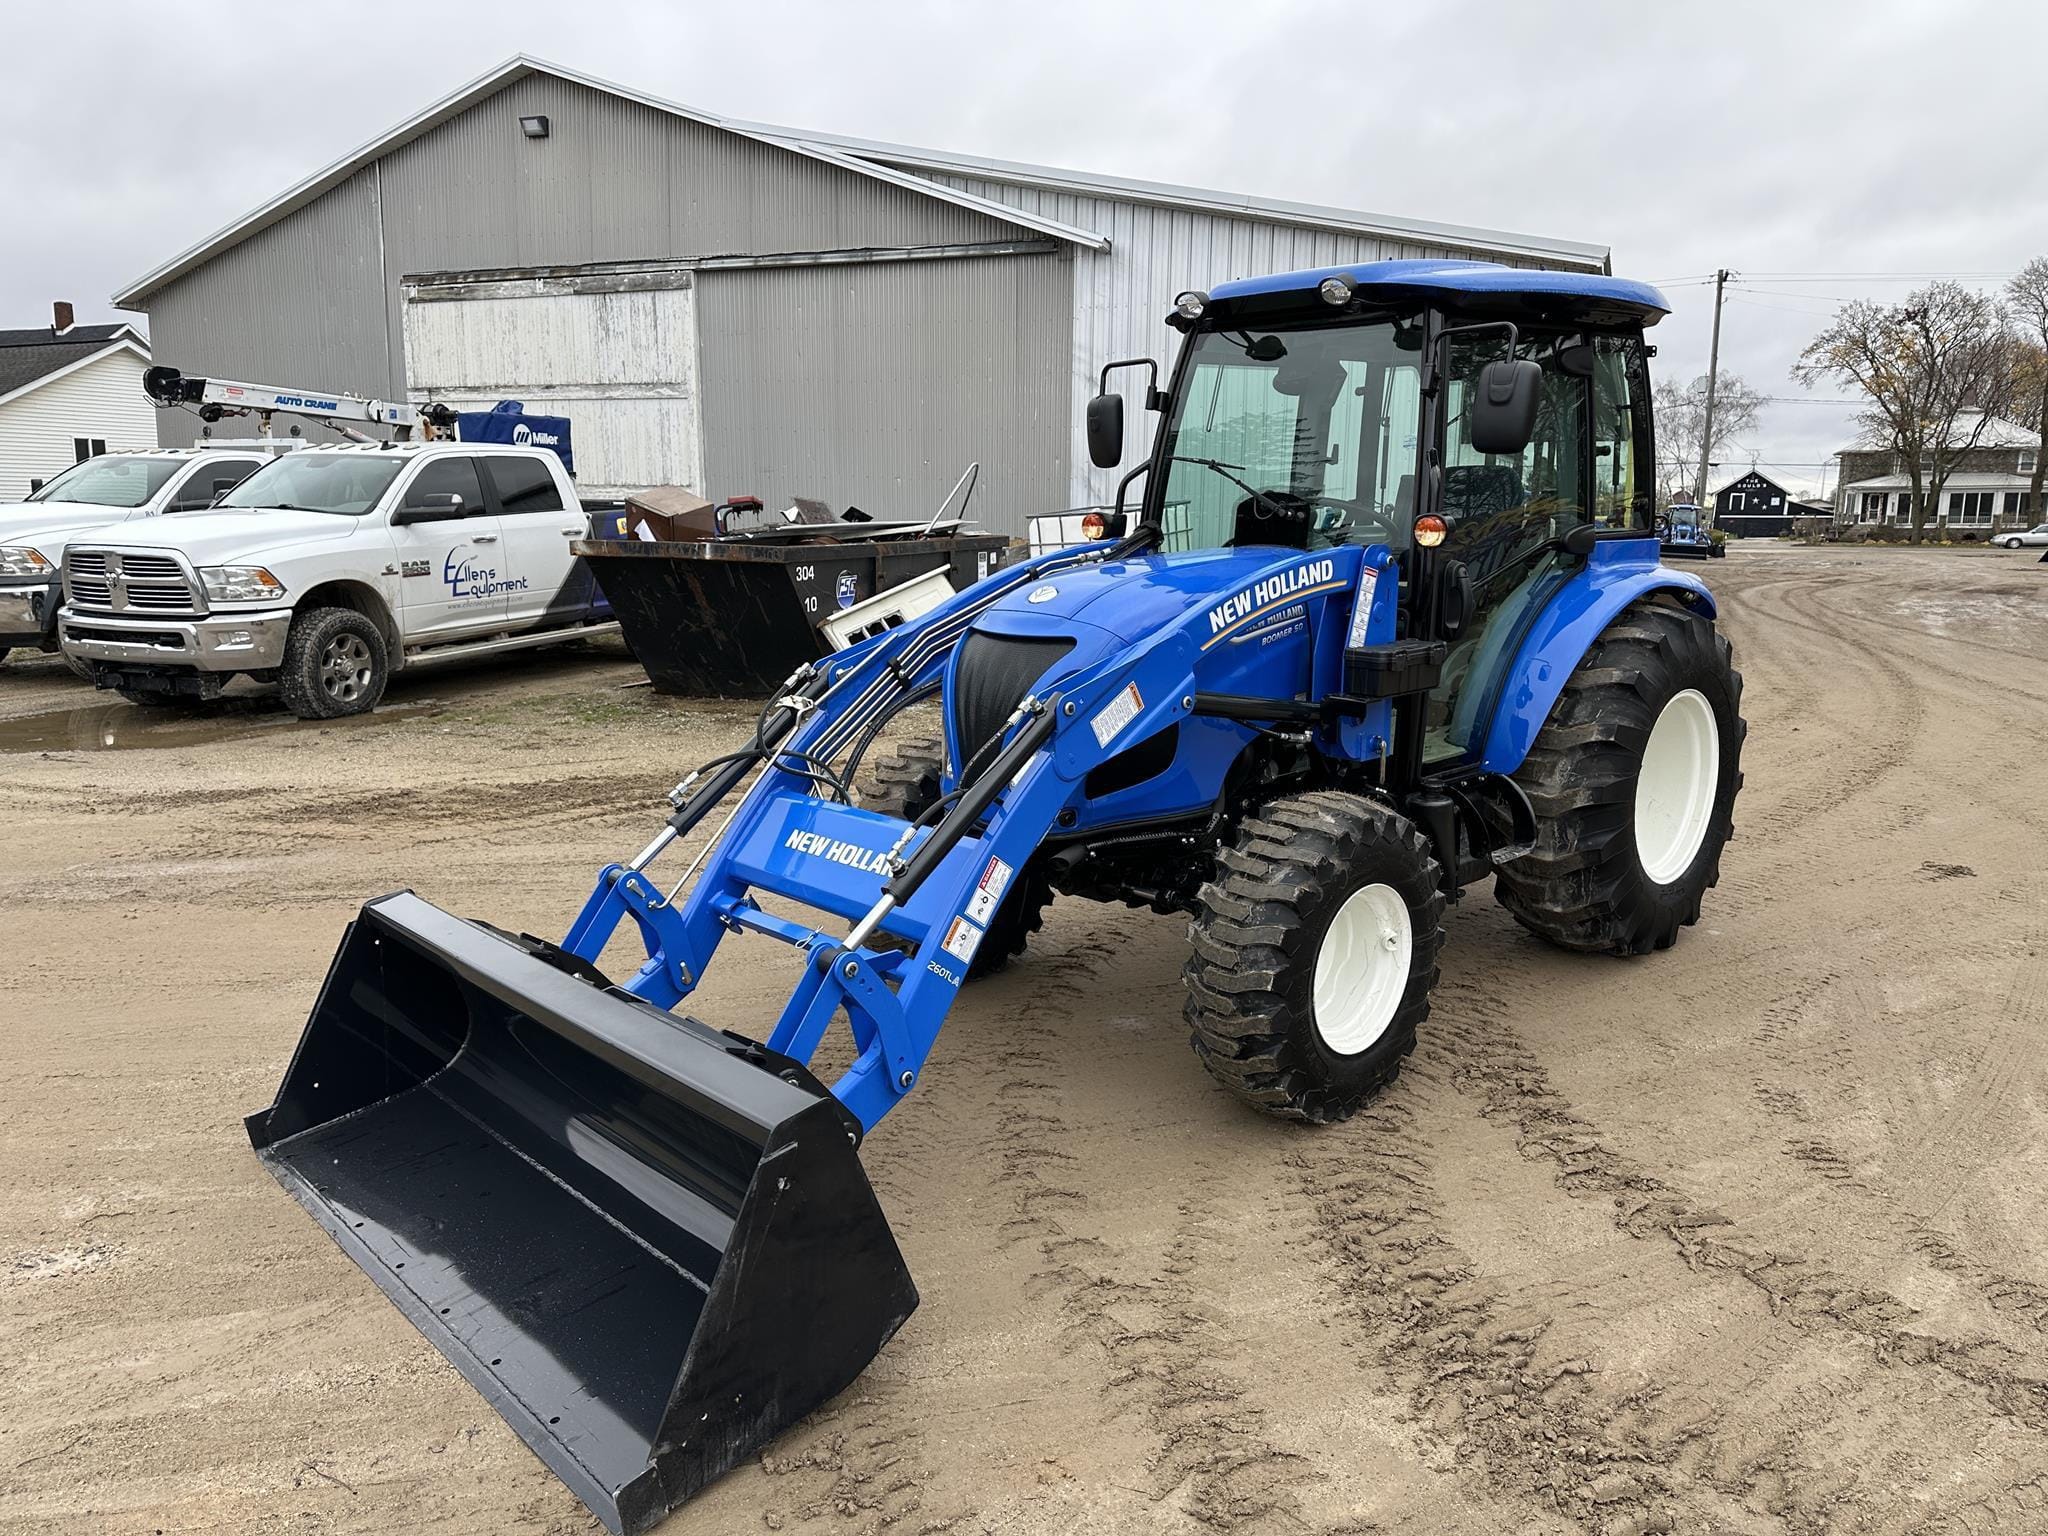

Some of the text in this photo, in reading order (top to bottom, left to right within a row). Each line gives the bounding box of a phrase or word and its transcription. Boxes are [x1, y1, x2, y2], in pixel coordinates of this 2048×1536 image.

[275, 395, 337, 410] AUTO CRANE
[532, 431, 559, 445] Miller
[444, 544, 496, 584] Ellens
[796, 565, 815, 582] 304
[452, 556, 529, 599] Equipment
[804, 596, 818, 613] 10
[1208, 559, 1334, 634] NEW HOLLAND
[1262, 626, 1293, 646] BOOMER
[1294, 622, 1304, 632] 50
[784, 828, 899, 878] NEW HOLLAN
[926, 960, 960, 987] 260TLA
